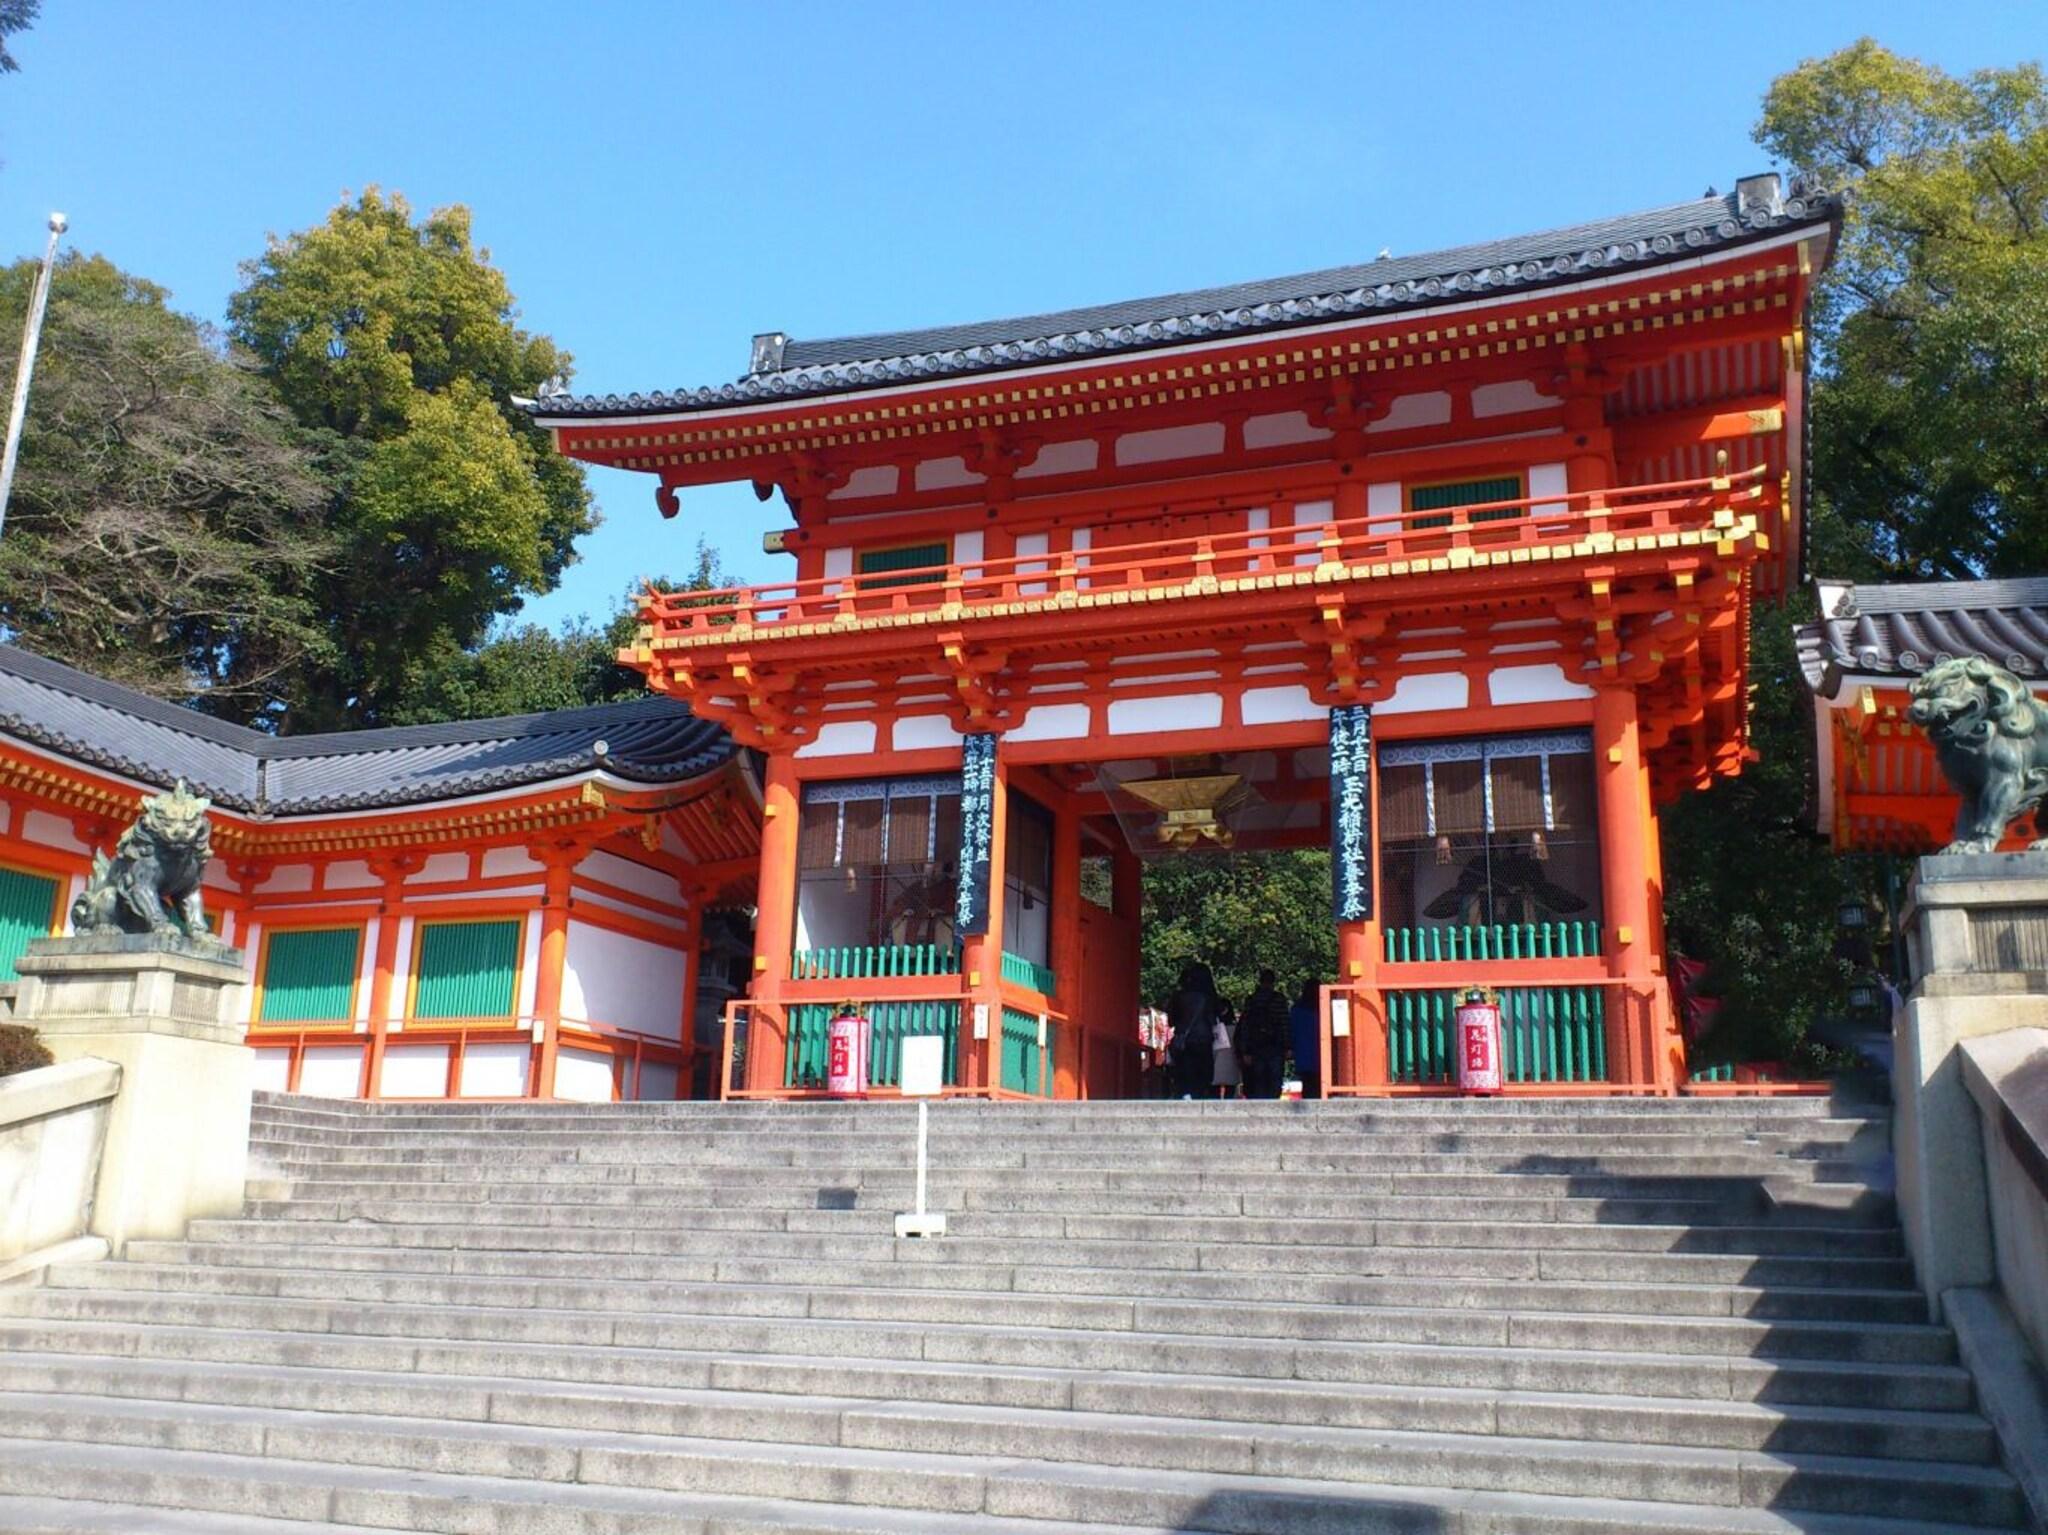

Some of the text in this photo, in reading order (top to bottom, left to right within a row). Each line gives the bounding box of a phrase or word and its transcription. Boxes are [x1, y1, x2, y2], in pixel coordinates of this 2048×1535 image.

[1330, 708, 1352, 776] 午後二時
[1350, 706, 1370, 773] 三月十三日
